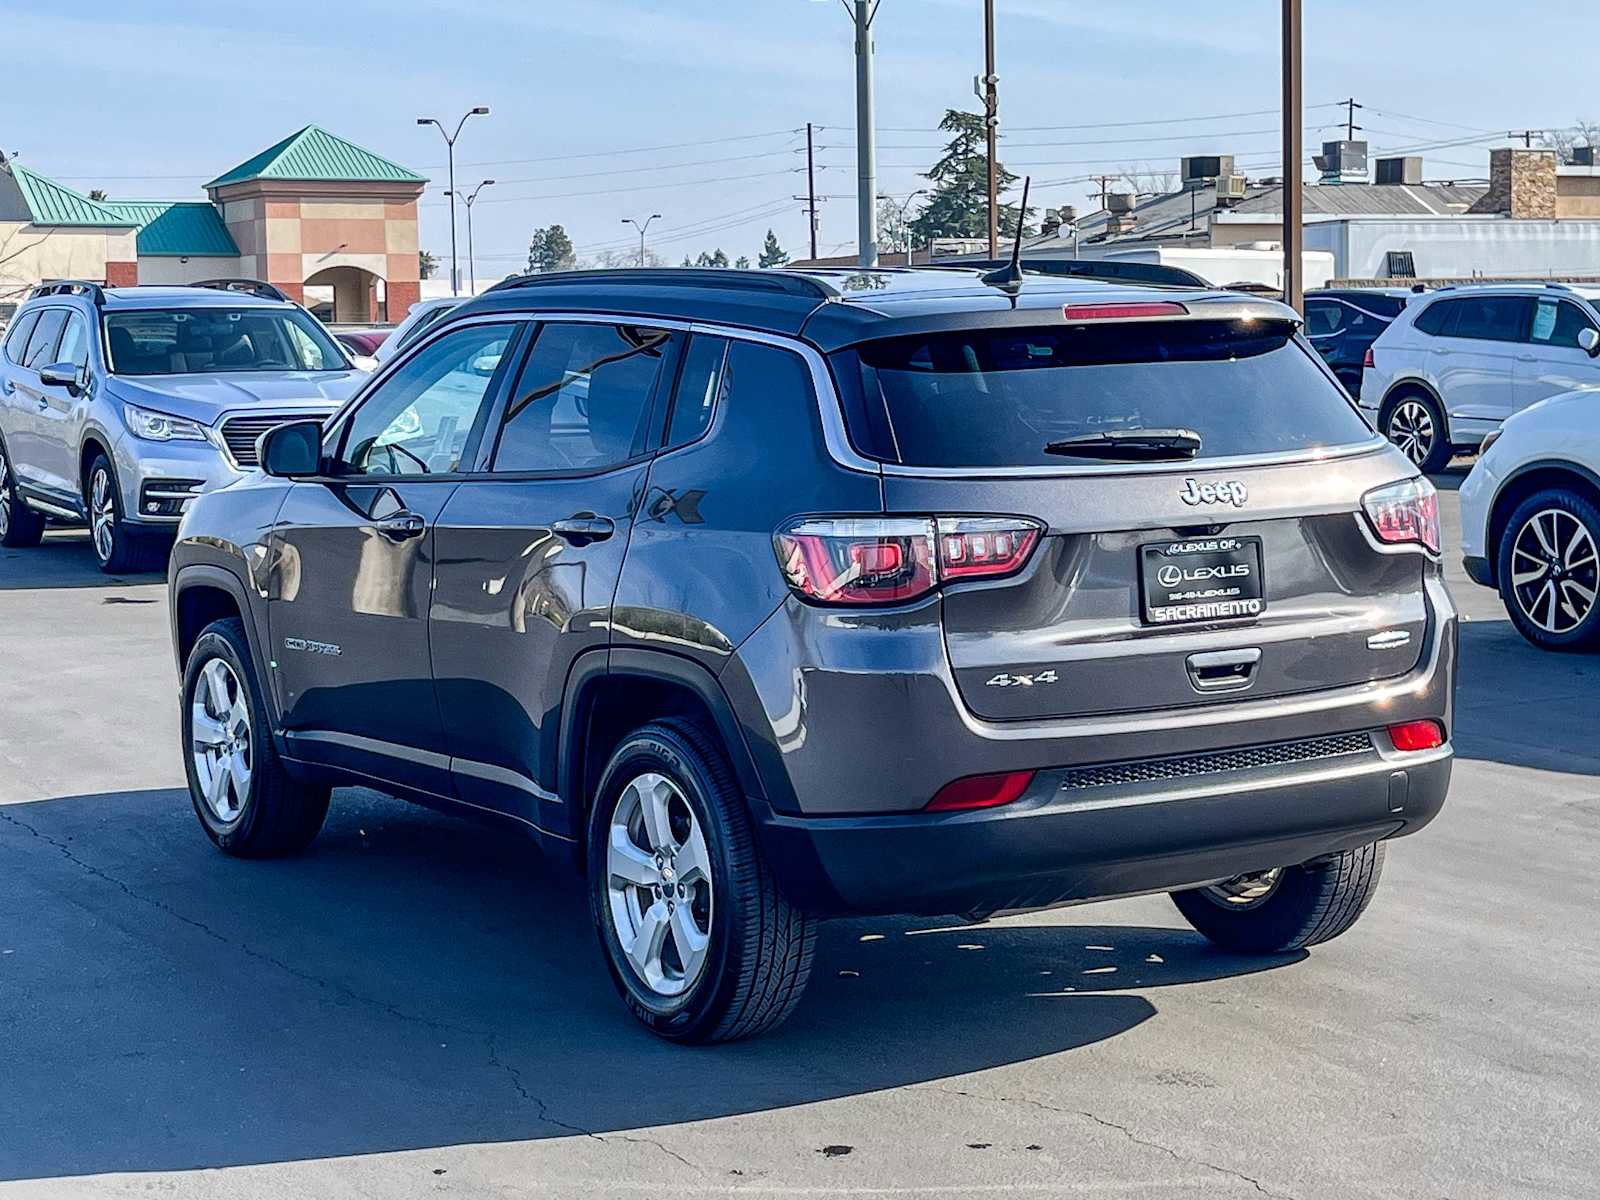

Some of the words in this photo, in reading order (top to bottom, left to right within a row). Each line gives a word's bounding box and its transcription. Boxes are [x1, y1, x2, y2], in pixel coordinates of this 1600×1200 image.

[1179, 478, 1248, 507] Jeep
[1180, 541, 1218, 552] LEXUS
[1219, 539, 1236, 550] OF
[1183, 564, 1250, 580] LEXUS
[1154, 600, 1261, 621] SACRAMENTO
[985, 669, 1059, 687] 4x4
